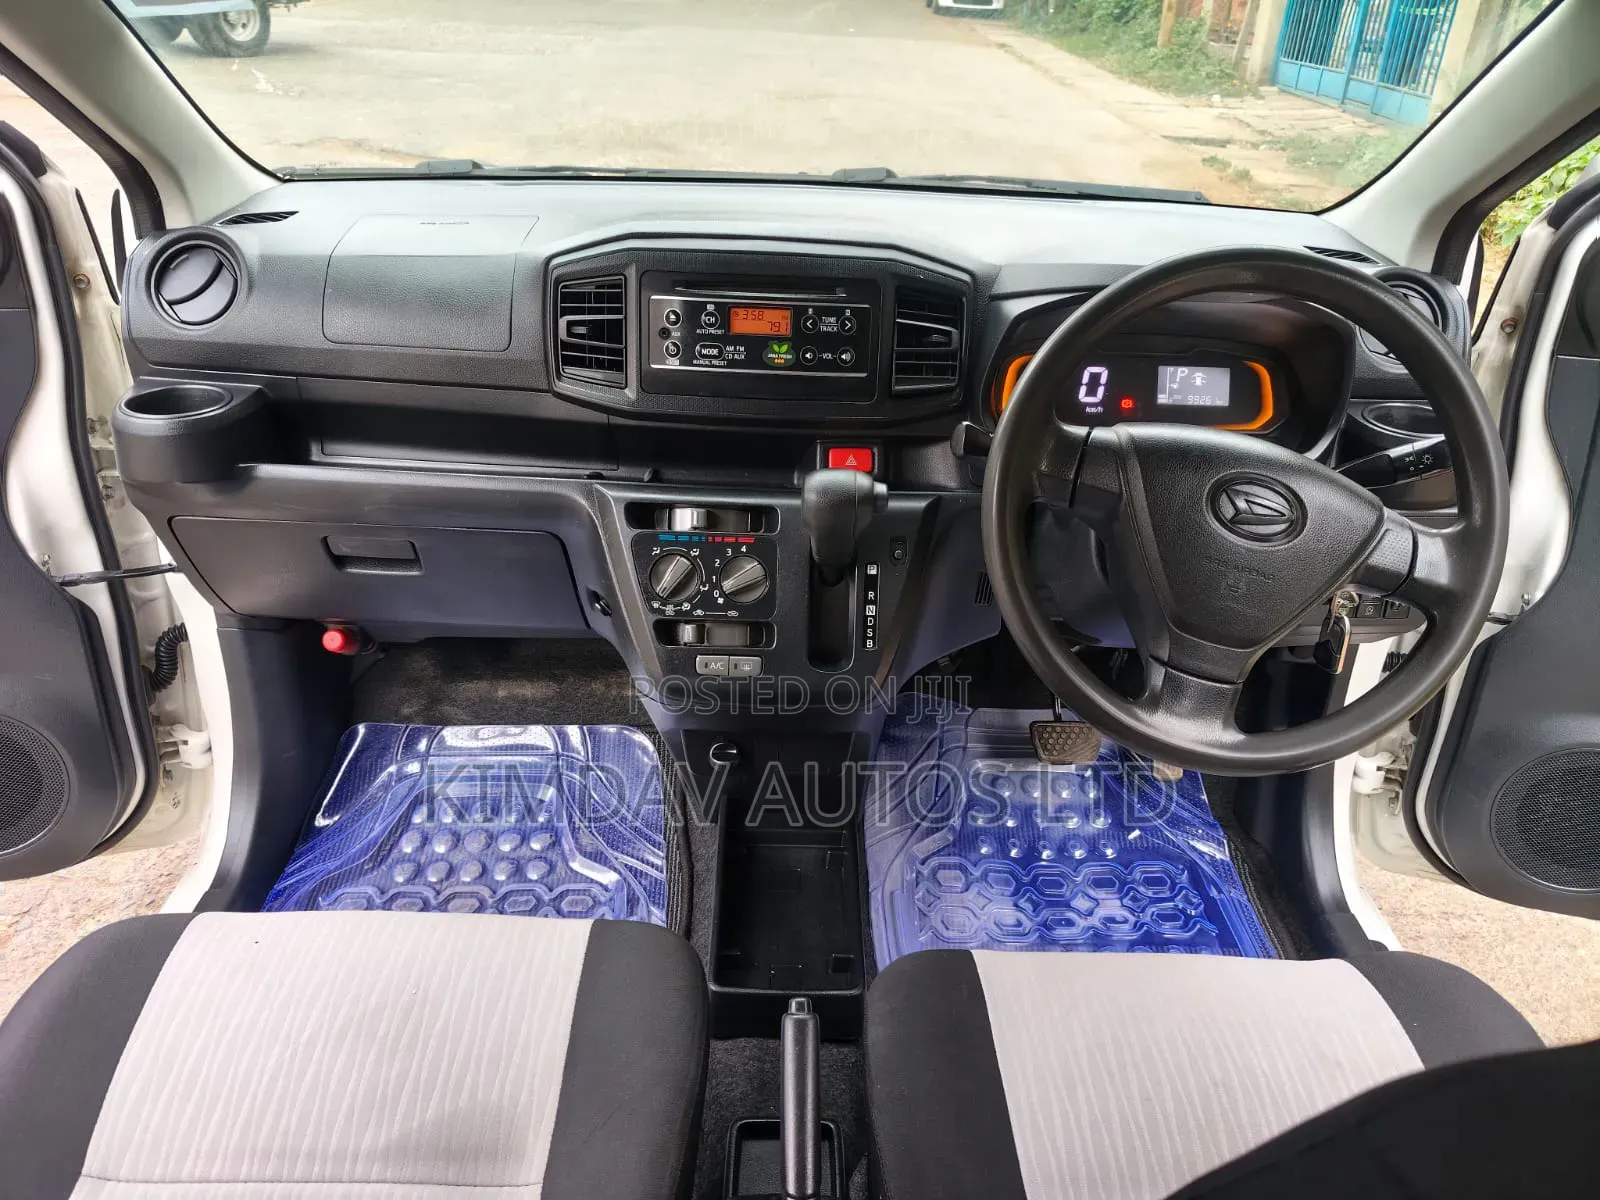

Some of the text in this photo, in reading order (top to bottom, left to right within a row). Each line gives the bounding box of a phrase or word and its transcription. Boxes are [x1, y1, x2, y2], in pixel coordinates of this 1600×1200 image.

[705, 316, 715, 324] CH
[1176, 367, 1189, 382] P
[1078, 366, 1109, 403] 0
[725, 548, 732, 556] 3
[740, 545, 747, 553] 4
[714, 559, 720, 567] 2
[868, 564, 876, 574] P
[713, 590, 720, 598] 0
[868, 591, 875, 601] R
[867, 606, 875, 615] N
[867, 617, 874, 626] D
[866, 629, 873, 637] S
[866, 640, 873, 648] B
[710, 662, 725, 670] A/C
